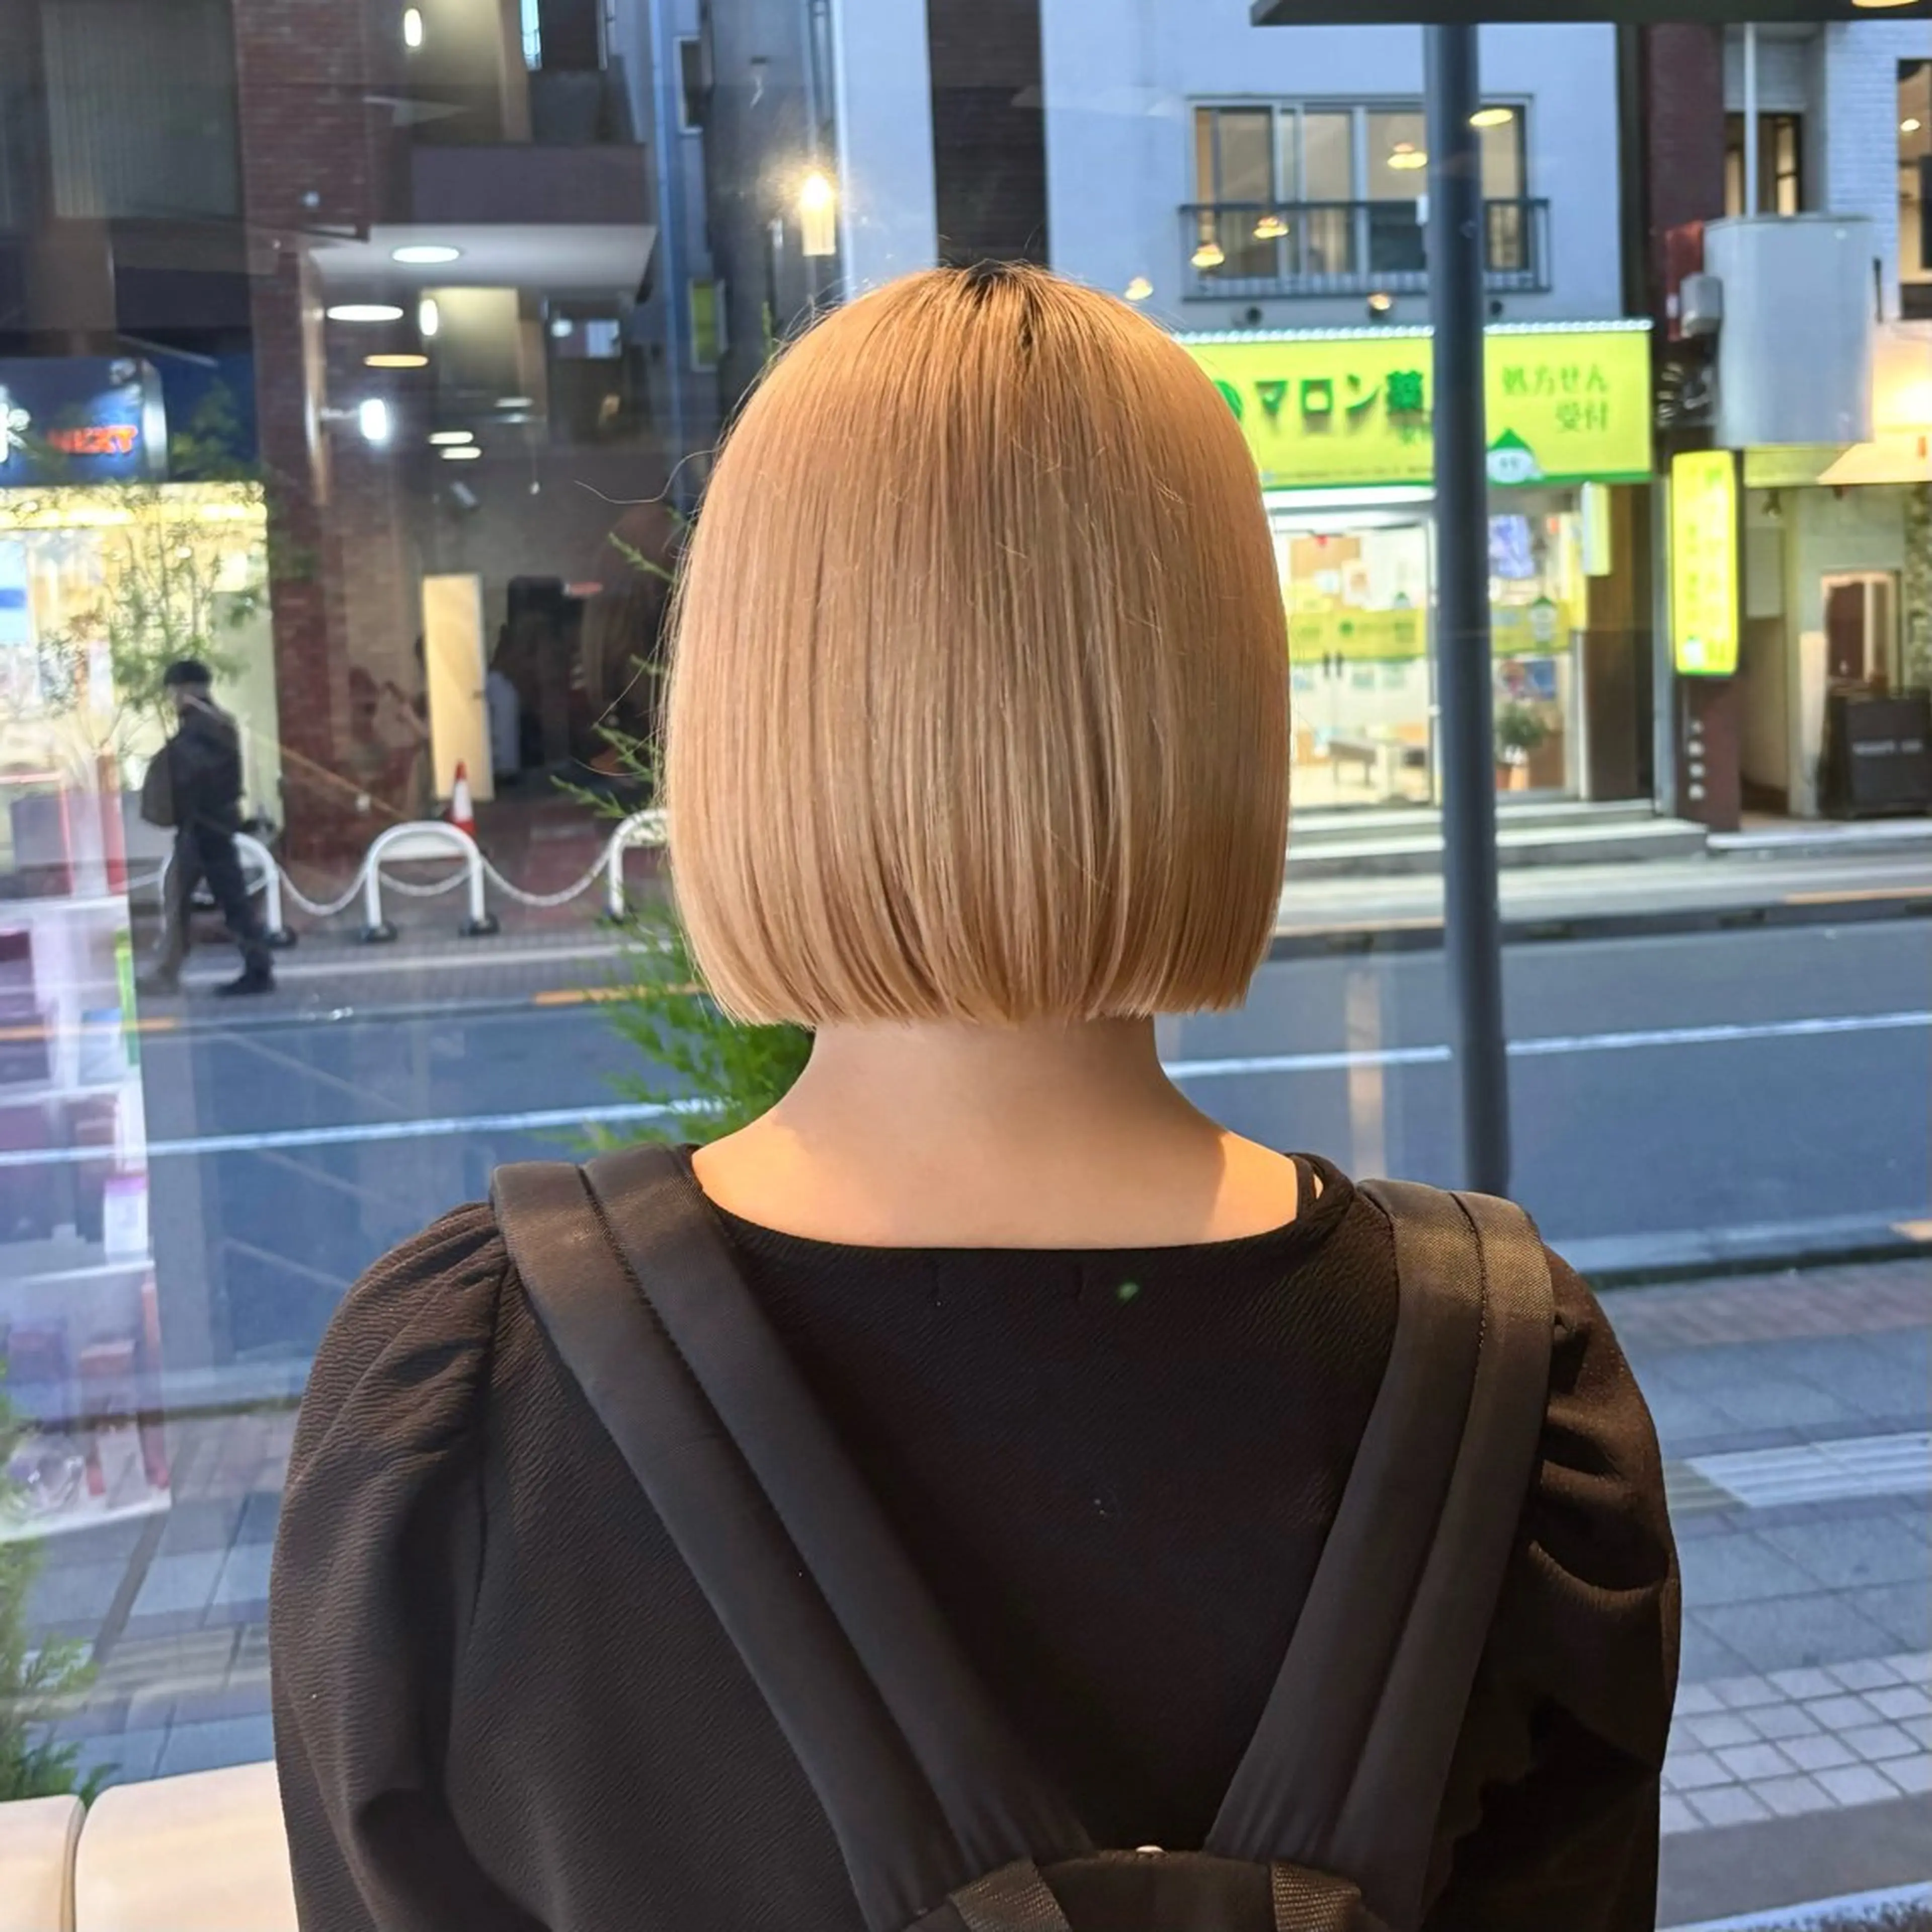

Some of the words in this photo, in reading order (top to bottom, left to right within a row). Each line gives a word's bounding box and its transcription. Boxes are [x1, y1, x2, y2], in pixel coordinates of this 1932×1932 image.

[1501, 363, 1609, 396] 処方せん
[1555, 401, 1609, 433] 受付
